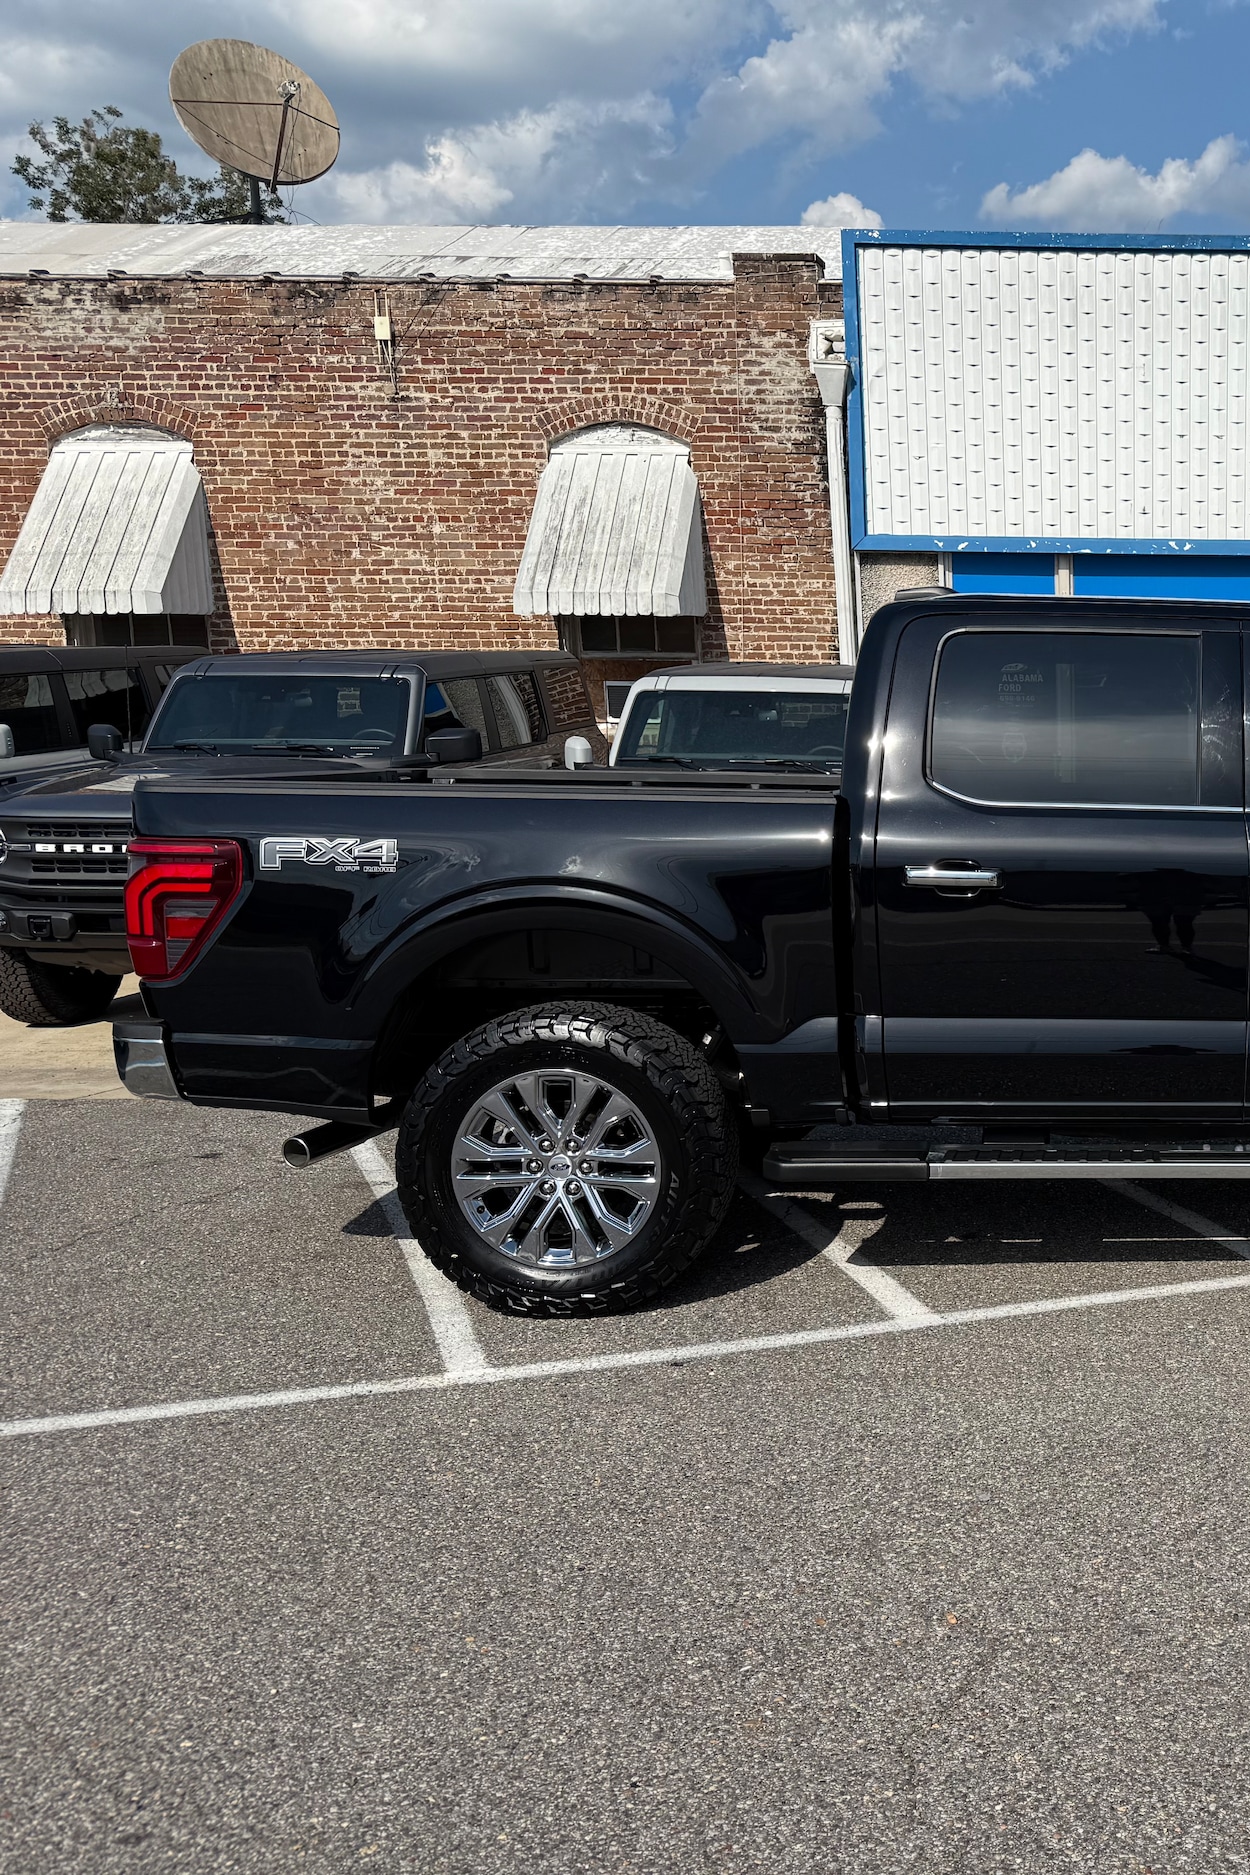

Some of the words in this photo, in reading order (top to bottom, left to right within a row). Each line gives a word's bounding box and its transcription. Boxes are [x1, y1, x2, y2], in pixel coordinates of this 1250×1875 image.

[1001, 674, 1044, 683] ALABAMA
[998, 684, 1022, 692] FORD
[34, 843, 128, 853] BRO
[259, 836, 399, 871] FX4
